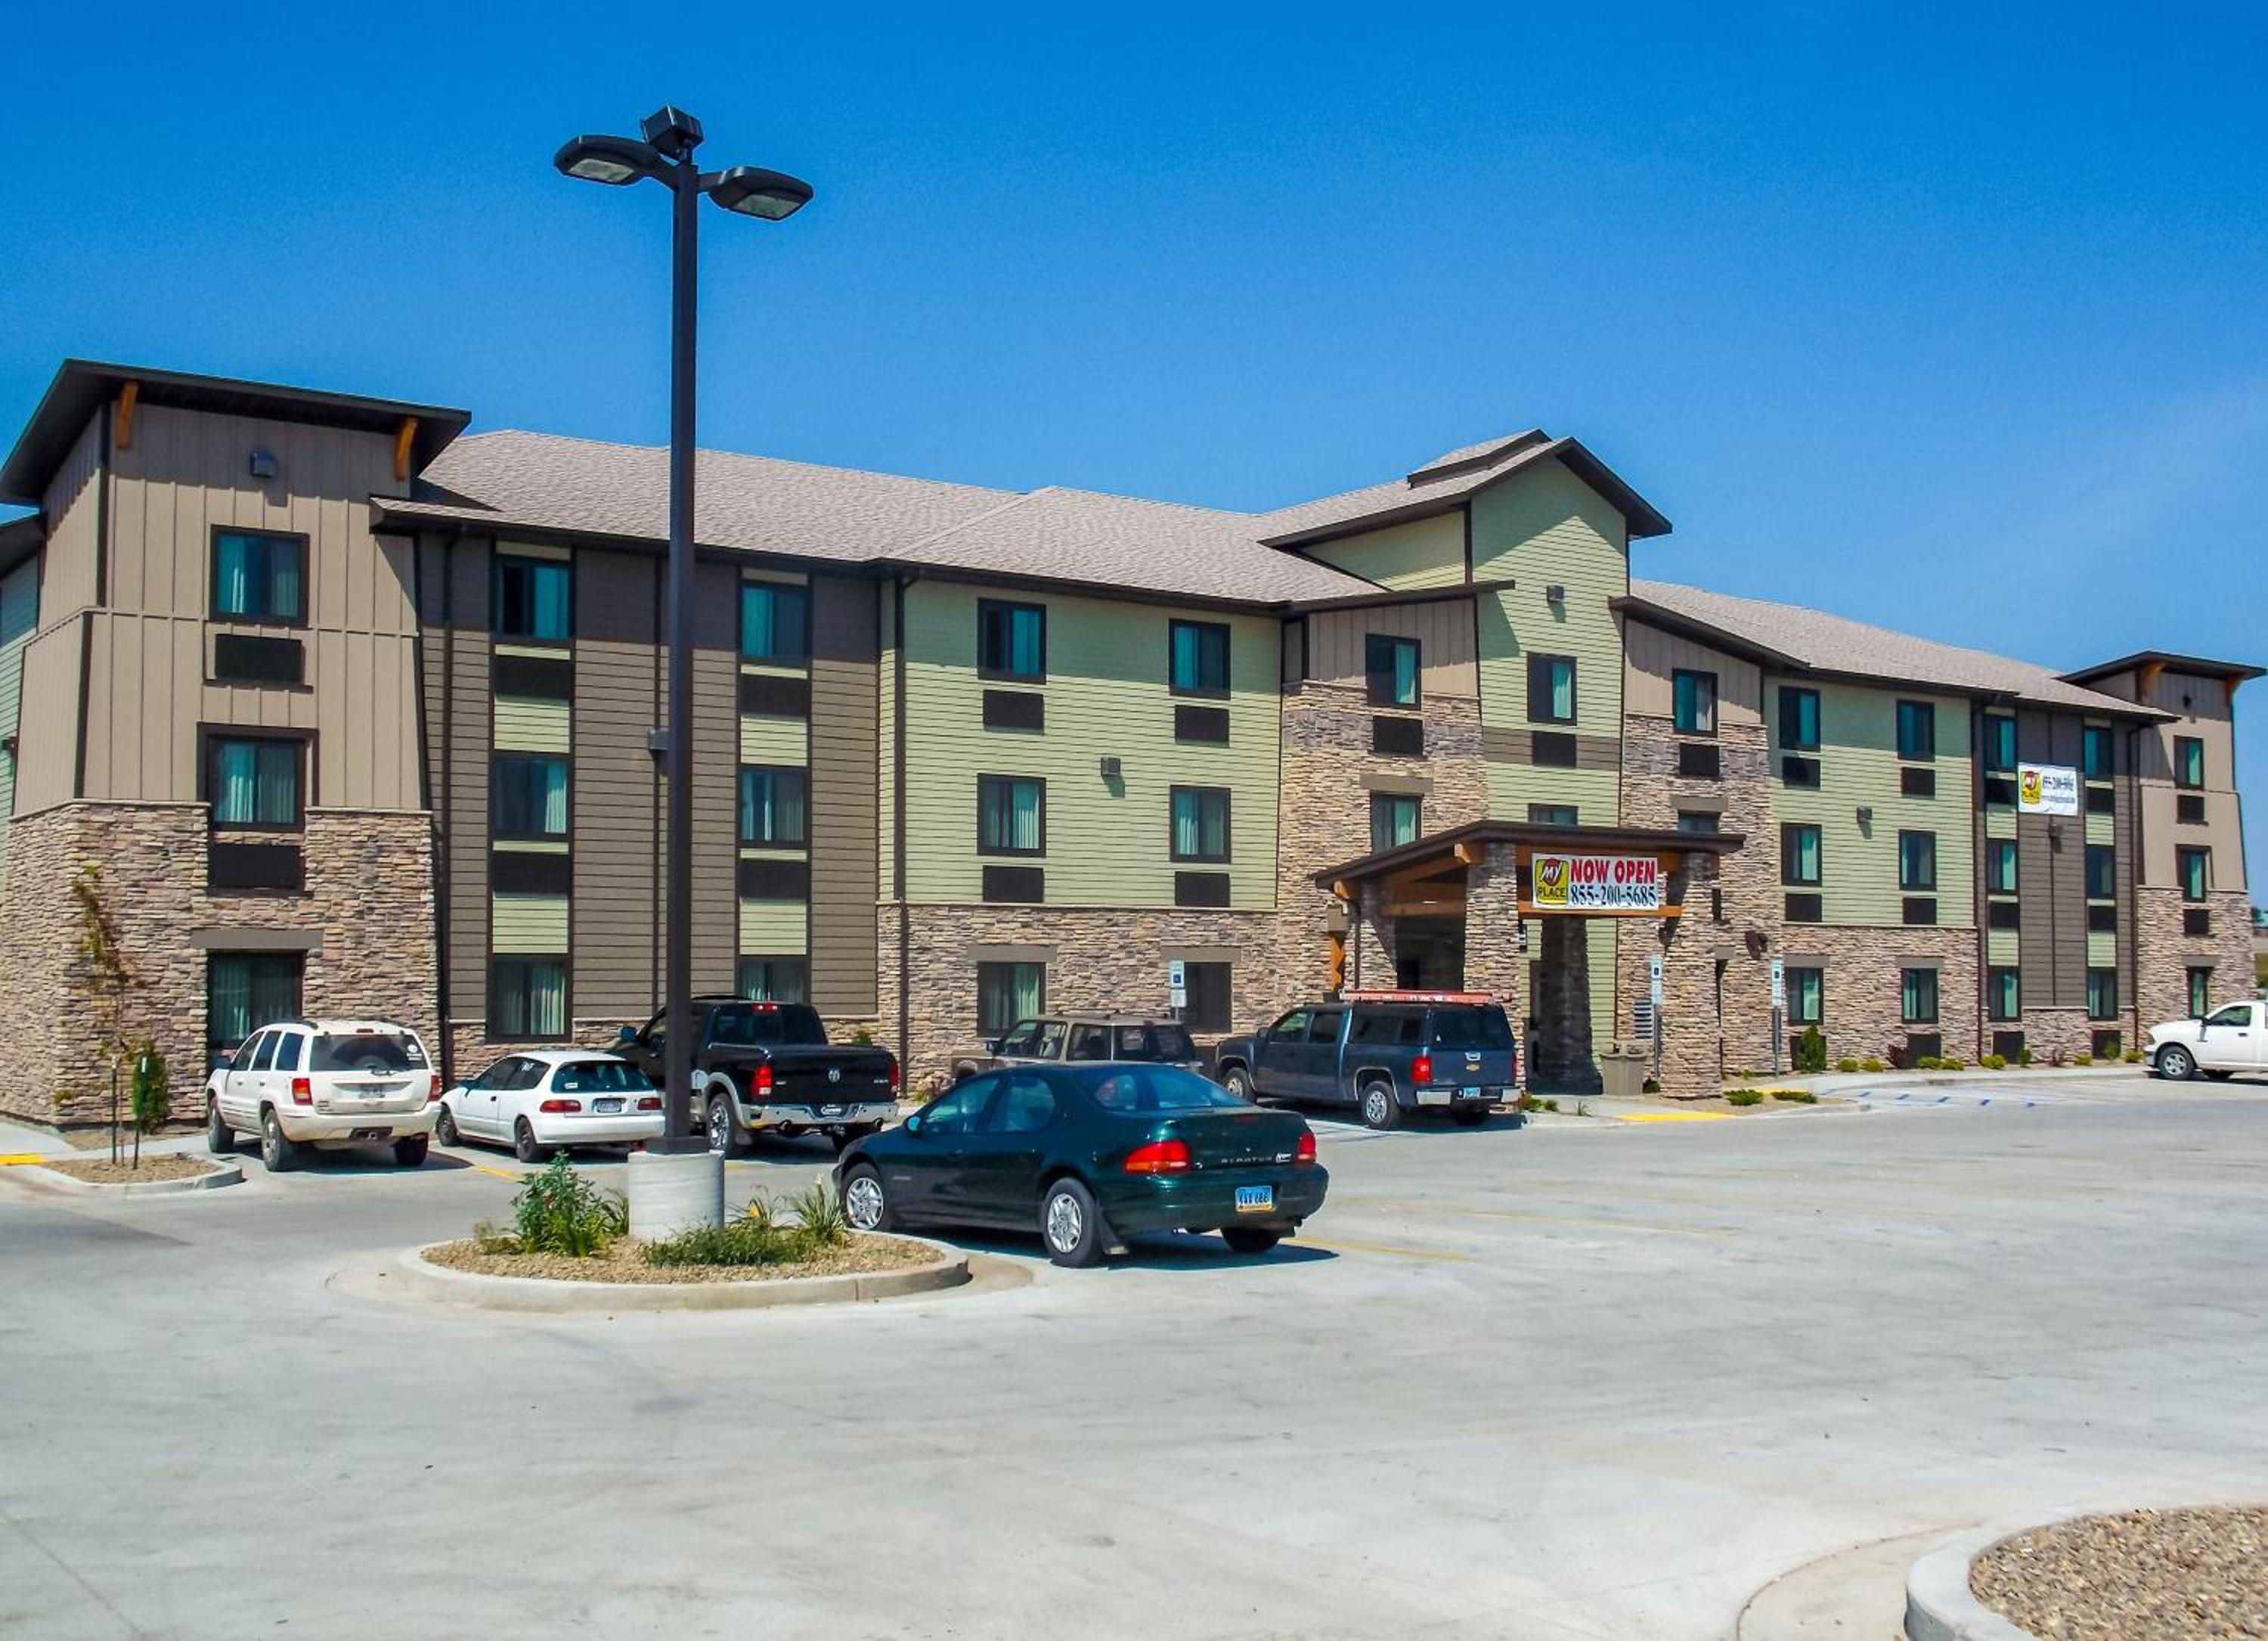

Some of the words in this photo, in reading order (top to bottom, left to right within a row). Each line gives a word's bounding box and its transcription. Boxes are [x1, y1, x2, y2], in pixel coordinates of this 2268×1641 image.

[1540, 861, 1563, 883] MY
[1571, 859, 1610, 883] NOW
[1615, 860, 1656, 884] OPEN
[1538, 886, 1566, 898] PLACE
[1571, 885, 1657, 906] 855-200-5685
